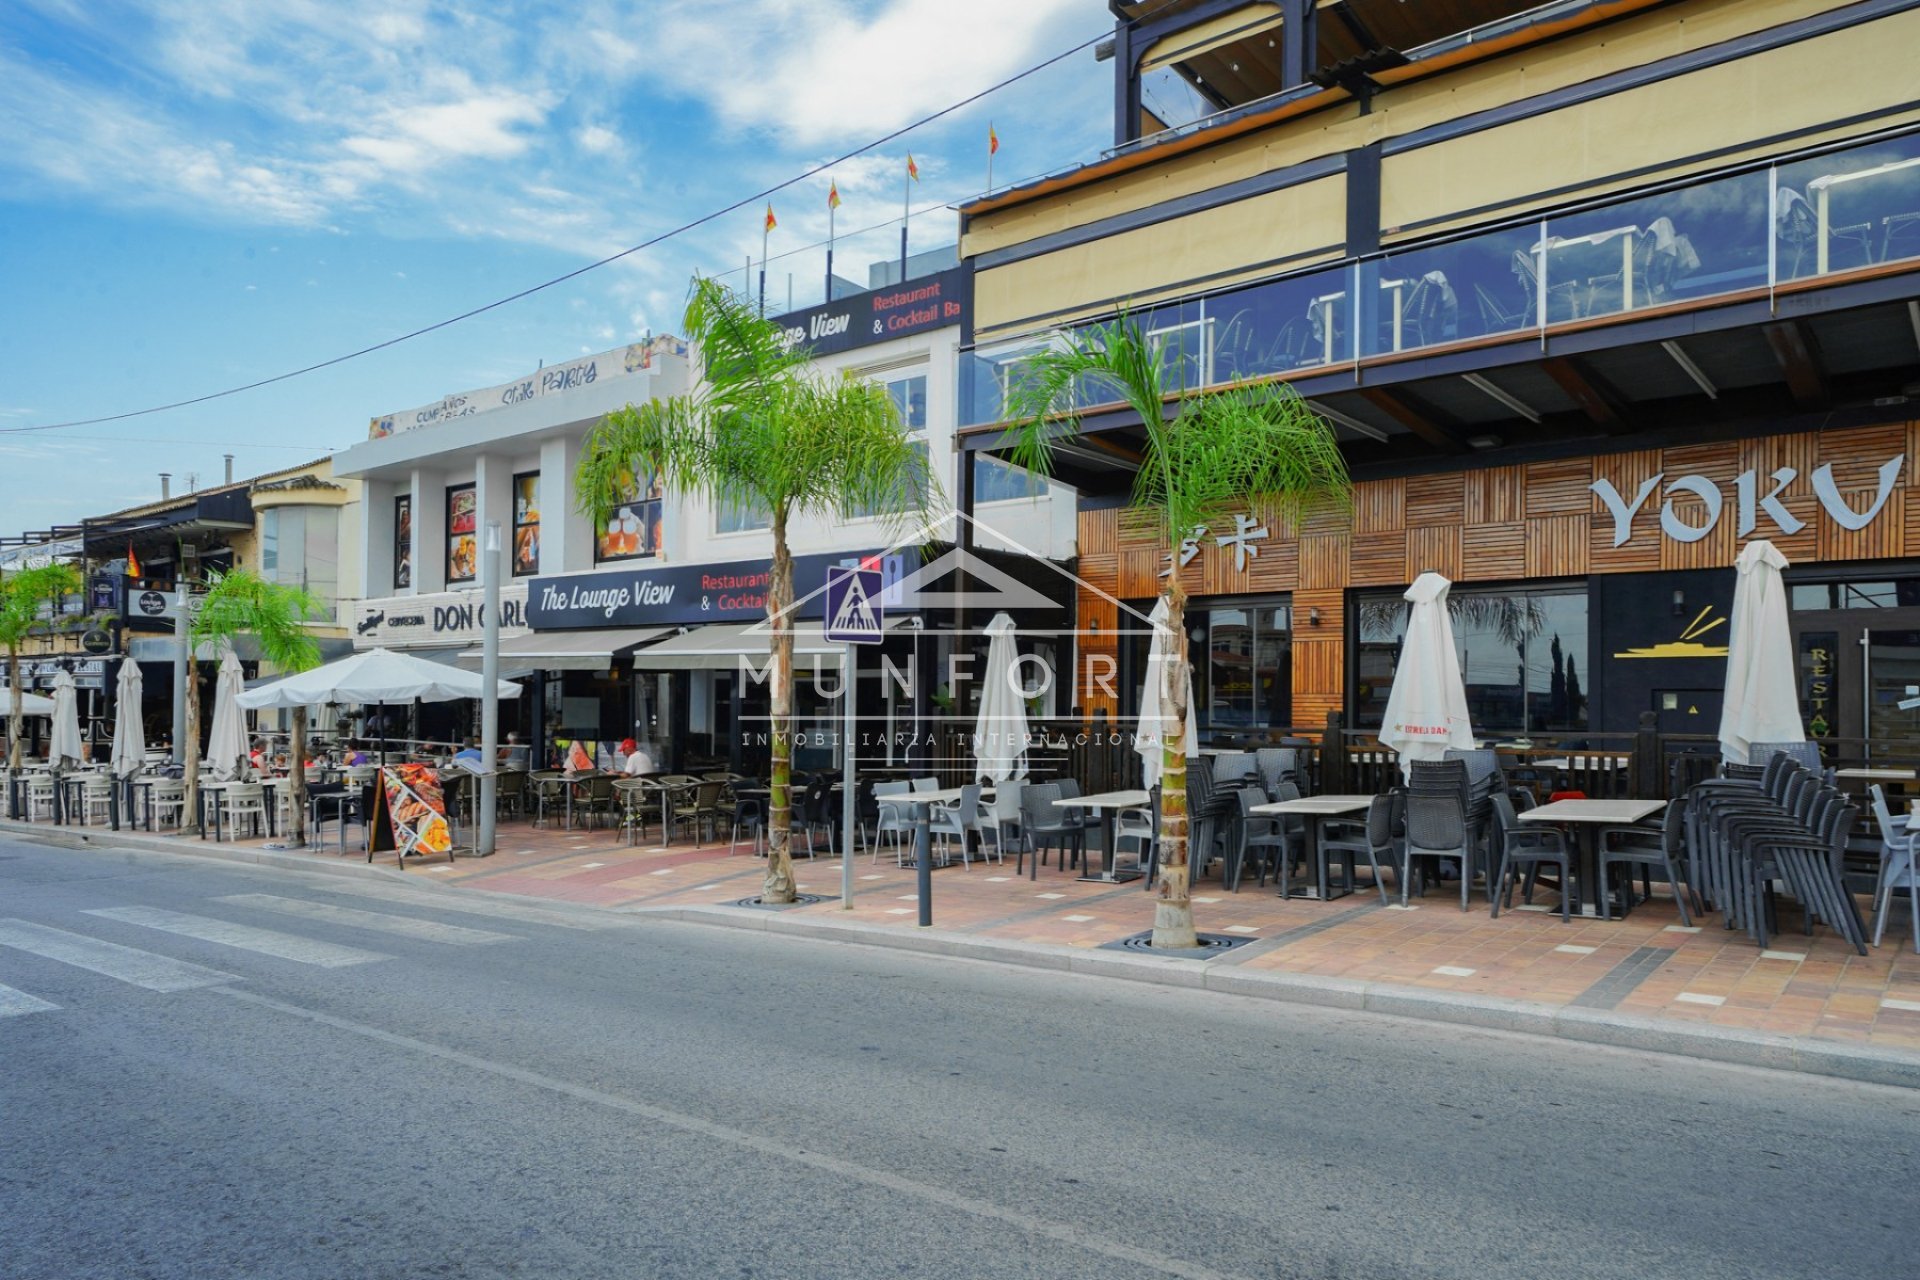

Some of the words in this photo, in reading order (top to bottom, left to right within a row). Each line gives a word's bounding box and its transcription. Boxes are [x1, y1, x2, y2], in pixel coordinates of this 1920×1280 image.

[873, 282, 941, 312] Restaurant
[810, 312, 850, 341] View
[873, 319, 883, 335] &
[887, 304, 938, 331] Cocktail
[944, 301, 960, 318] Ba
[1589, 453, 1905, 548] YOKU
[702, 572, 769, 590] Restaurant
[541, 584, 567, 611] The
[570, 587, 630, 618] Lounge
[634, 581, 676, 606] View
[701, 595, 711, 611] &
[718, 593, 769, 610] Cocktail
[434, 604, 473, 632] DON
[477, 599, 529, 629] CRL
